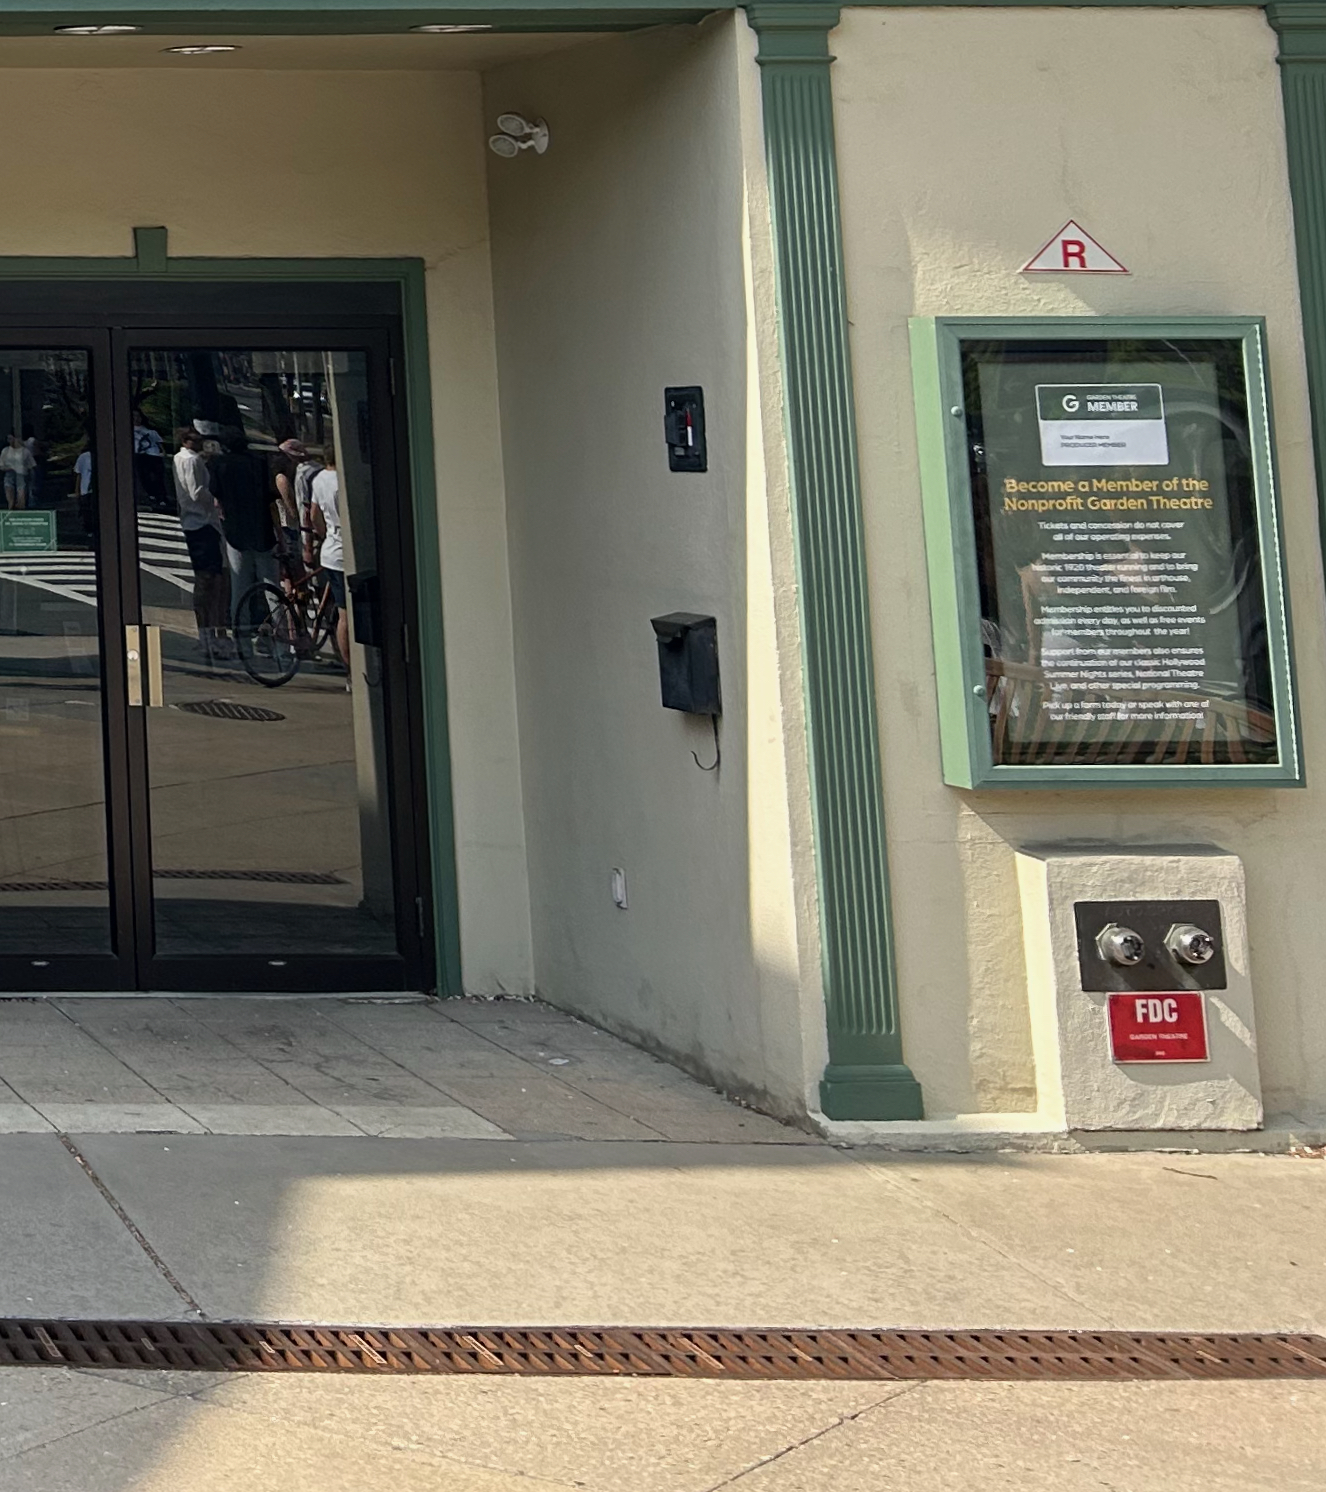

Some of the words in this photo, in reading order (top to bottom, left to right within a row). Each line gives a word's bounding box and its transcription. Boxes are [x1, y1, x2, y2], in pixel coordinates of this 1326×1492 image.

[1061, 240, 1087, 268] R
[1087, 402, 1138, 411] MEMBER
[1005, 479, 1074, 492] Become
[1078, 481, 1089, 491] a
[1093, 479, 1158, 491] Member
[1162, 477, 1179, 491] of
[1182, 477, 1209, 491] the
[1004, 496, 1083, 512] Nonprofit
[1087, 497, 1147, 510] Garden
[1149, 496, 1213, 509] Theatre
[1135, 999, 1178, 1023] FDC
